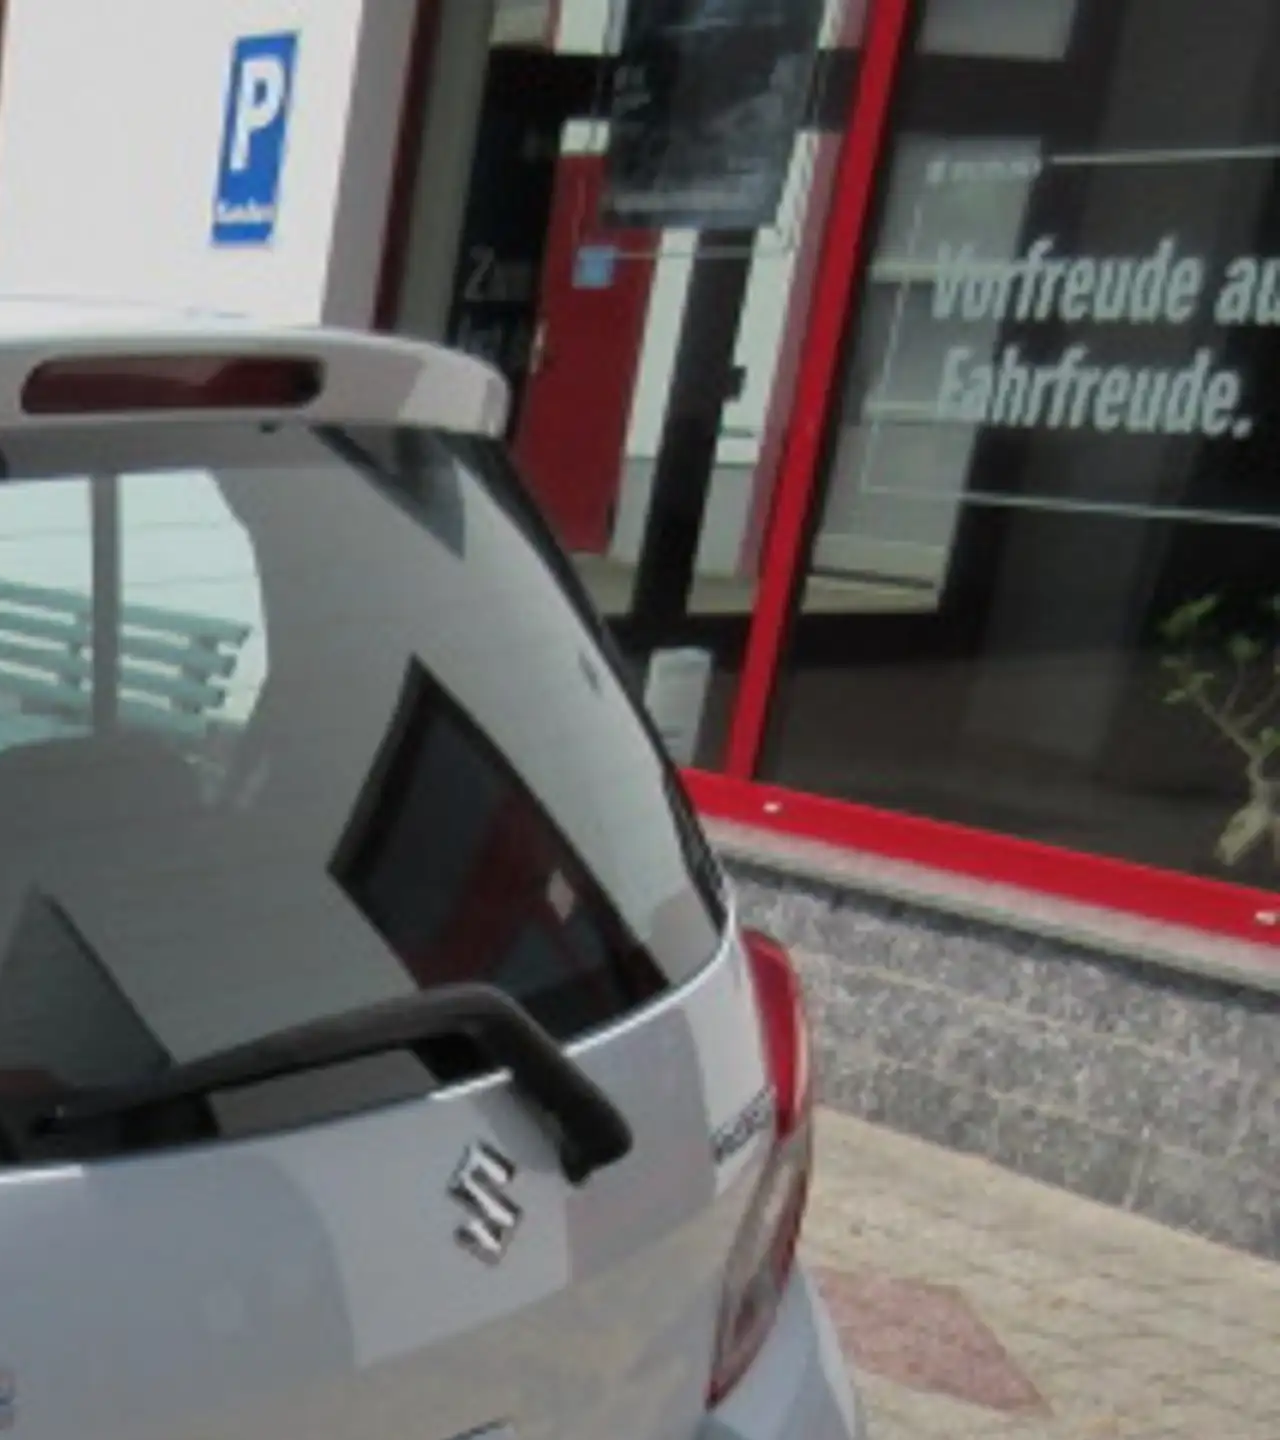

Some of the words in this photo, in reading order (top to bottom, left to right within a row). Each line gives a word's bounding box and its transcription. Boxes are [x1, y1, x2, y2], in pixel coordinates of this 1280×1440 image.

[230, 57, 285, 172] P
[930, 233, 1205, 326] Vorfreude
[938, 345, 1253, 440] Fahrfreude.
